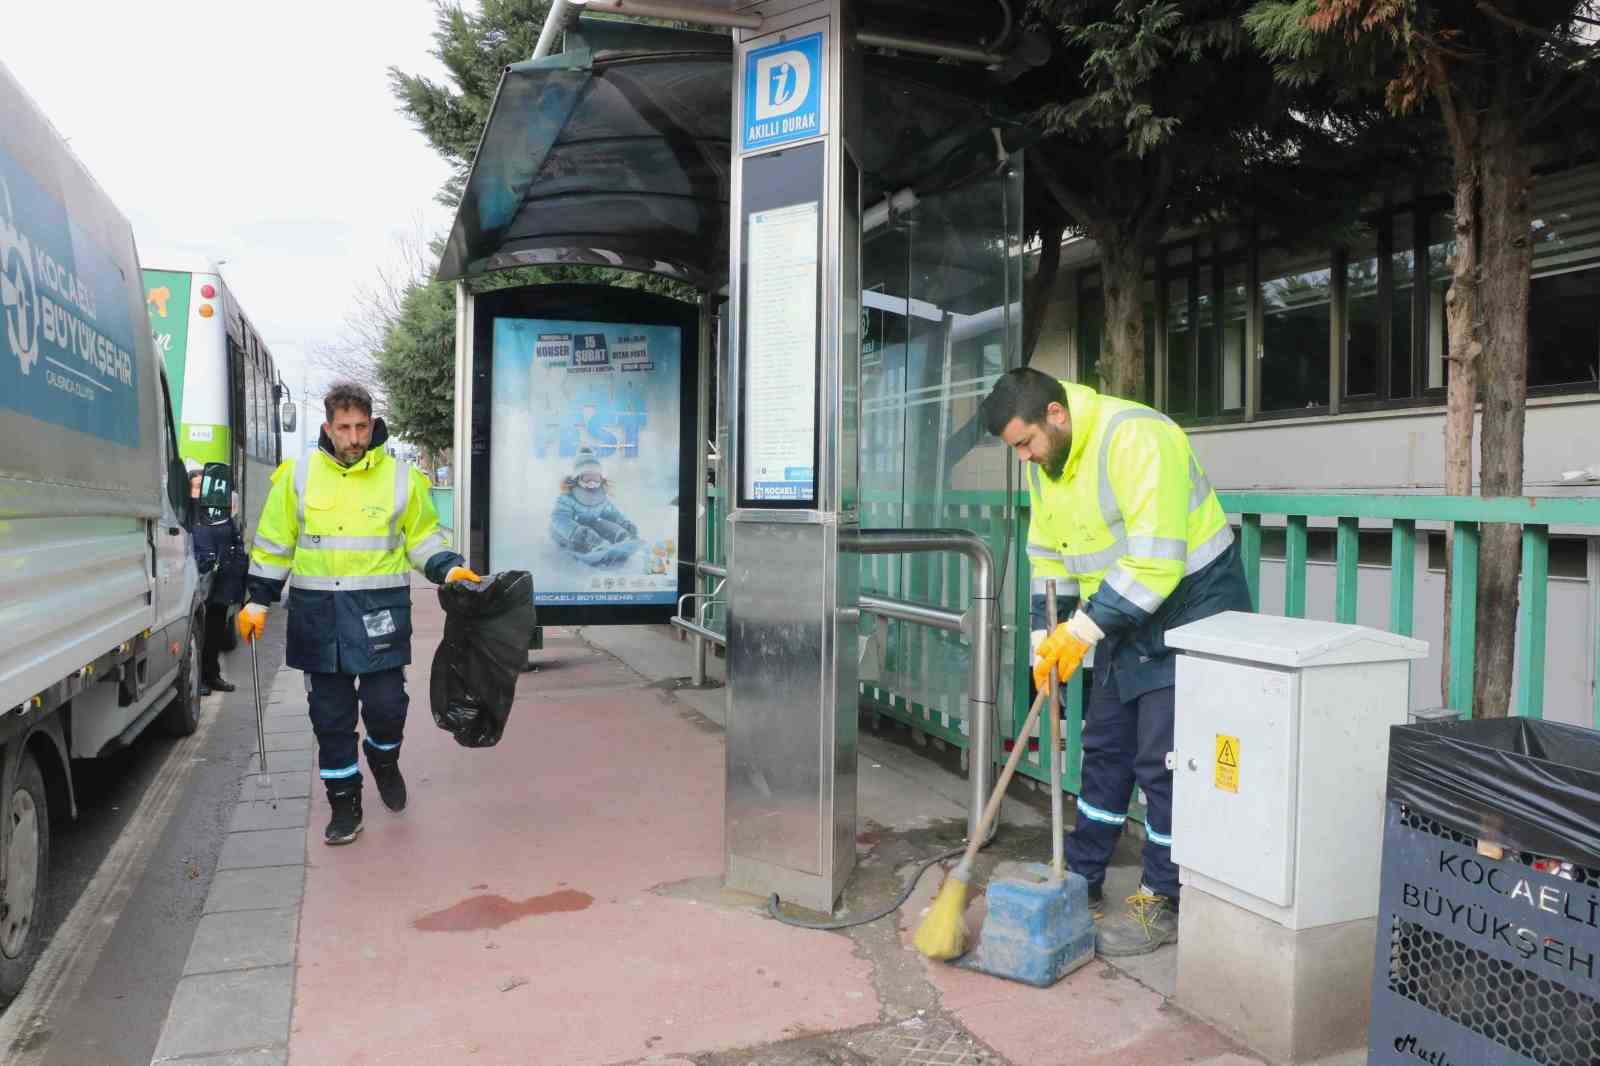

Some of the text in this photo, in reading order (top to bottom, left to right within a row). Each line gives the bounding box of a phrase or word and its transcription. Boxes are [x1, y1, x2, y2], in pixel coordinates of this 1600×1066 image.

[749, 112, 815, 143] AKILLI DURAK
[1439, 850, 1599, 928] KOCAELİ
[1394, 1033, 1451, 1066] Mutl
